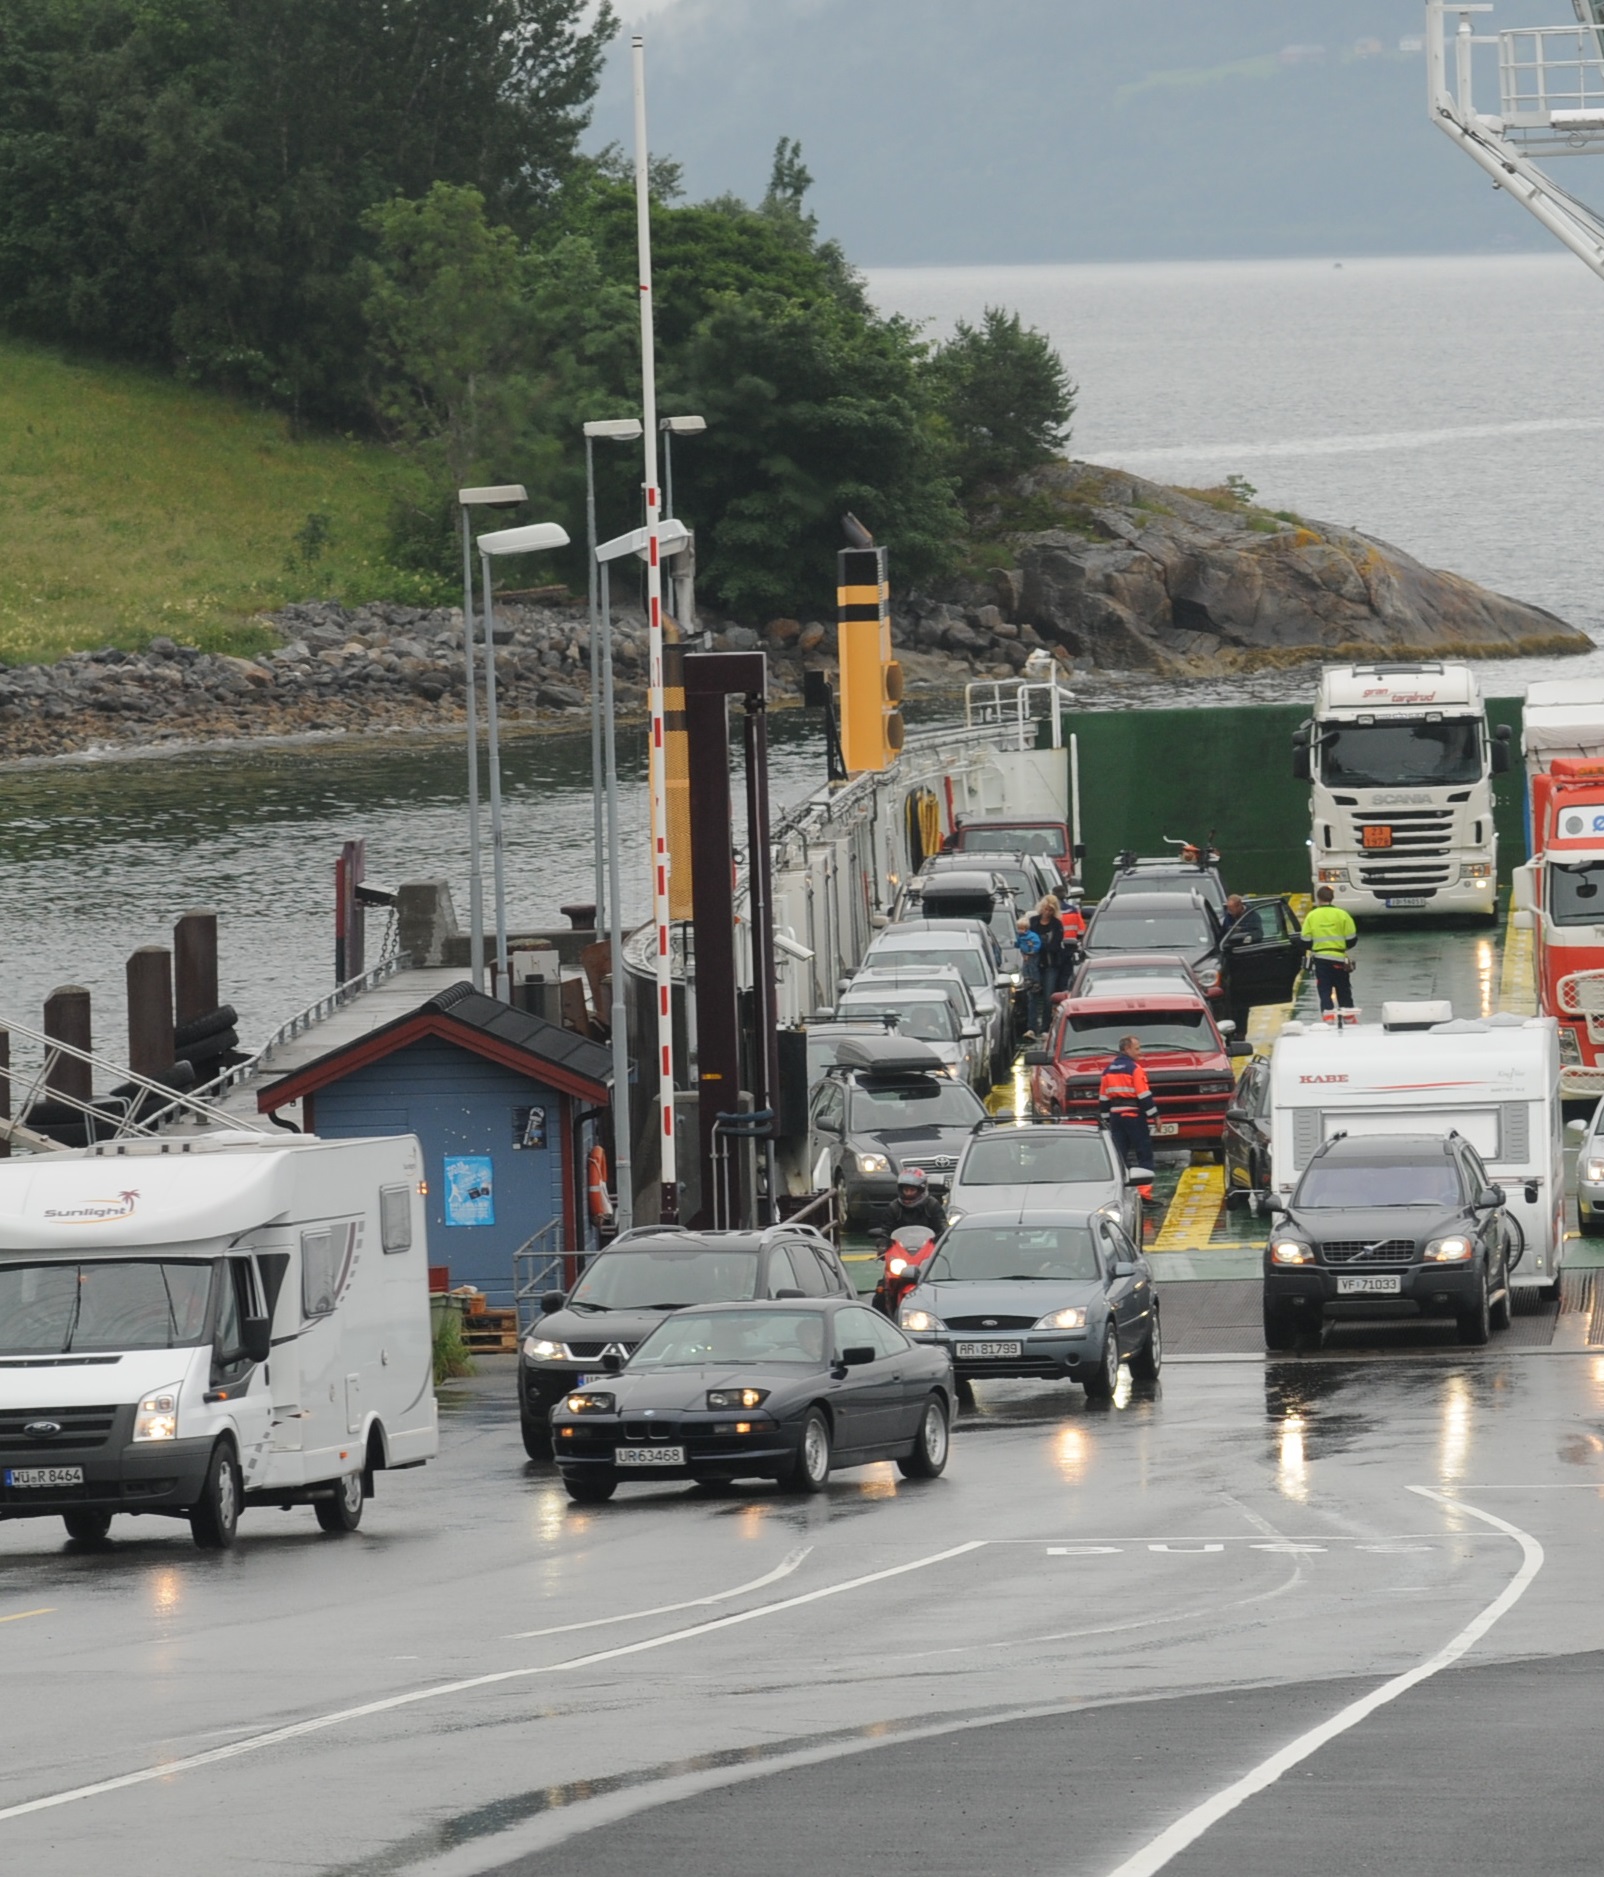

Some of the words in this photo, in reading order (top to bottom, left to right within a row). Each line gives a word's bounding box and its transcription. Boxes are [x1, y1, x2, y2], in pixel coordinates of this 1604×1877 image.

[1371, 794, 1433, 805] SCANIA
[1298, 1074, 1349, 1084] KABE
[43, 1207, 127, 1218] Sunlight
[1341, 1280, 1355, 1290] VF
[48, 1469, 81, 1482] 8464
